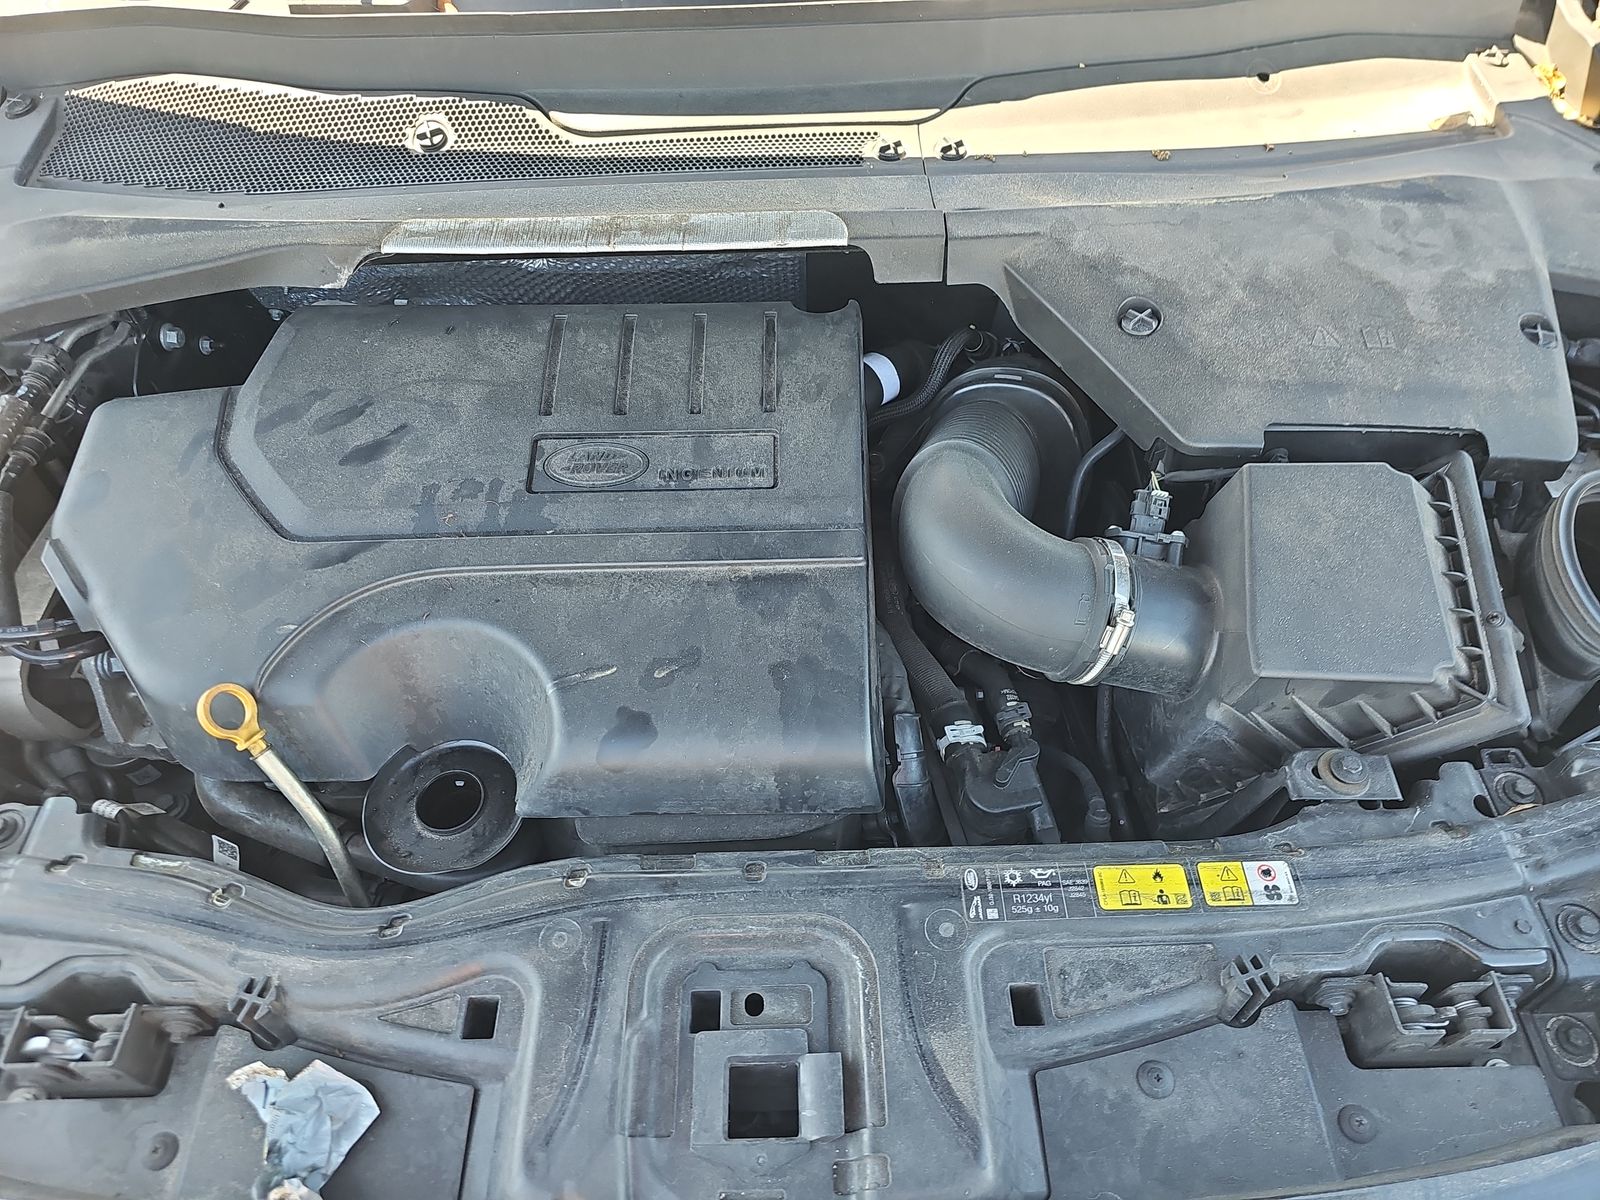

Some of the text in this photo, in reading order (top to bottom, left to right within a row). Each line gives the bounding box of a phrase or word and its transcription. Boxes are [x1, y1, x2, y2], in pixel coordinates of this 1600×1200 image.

[570, 462, 628, 474] ROVER
[658, 467, 767, 482] INGENIUM
[1012, 892, 1053, 904] R1234yf
[1011, 905, 1034, 914] 525g
[1043, 904, 1059, 913] 10g
